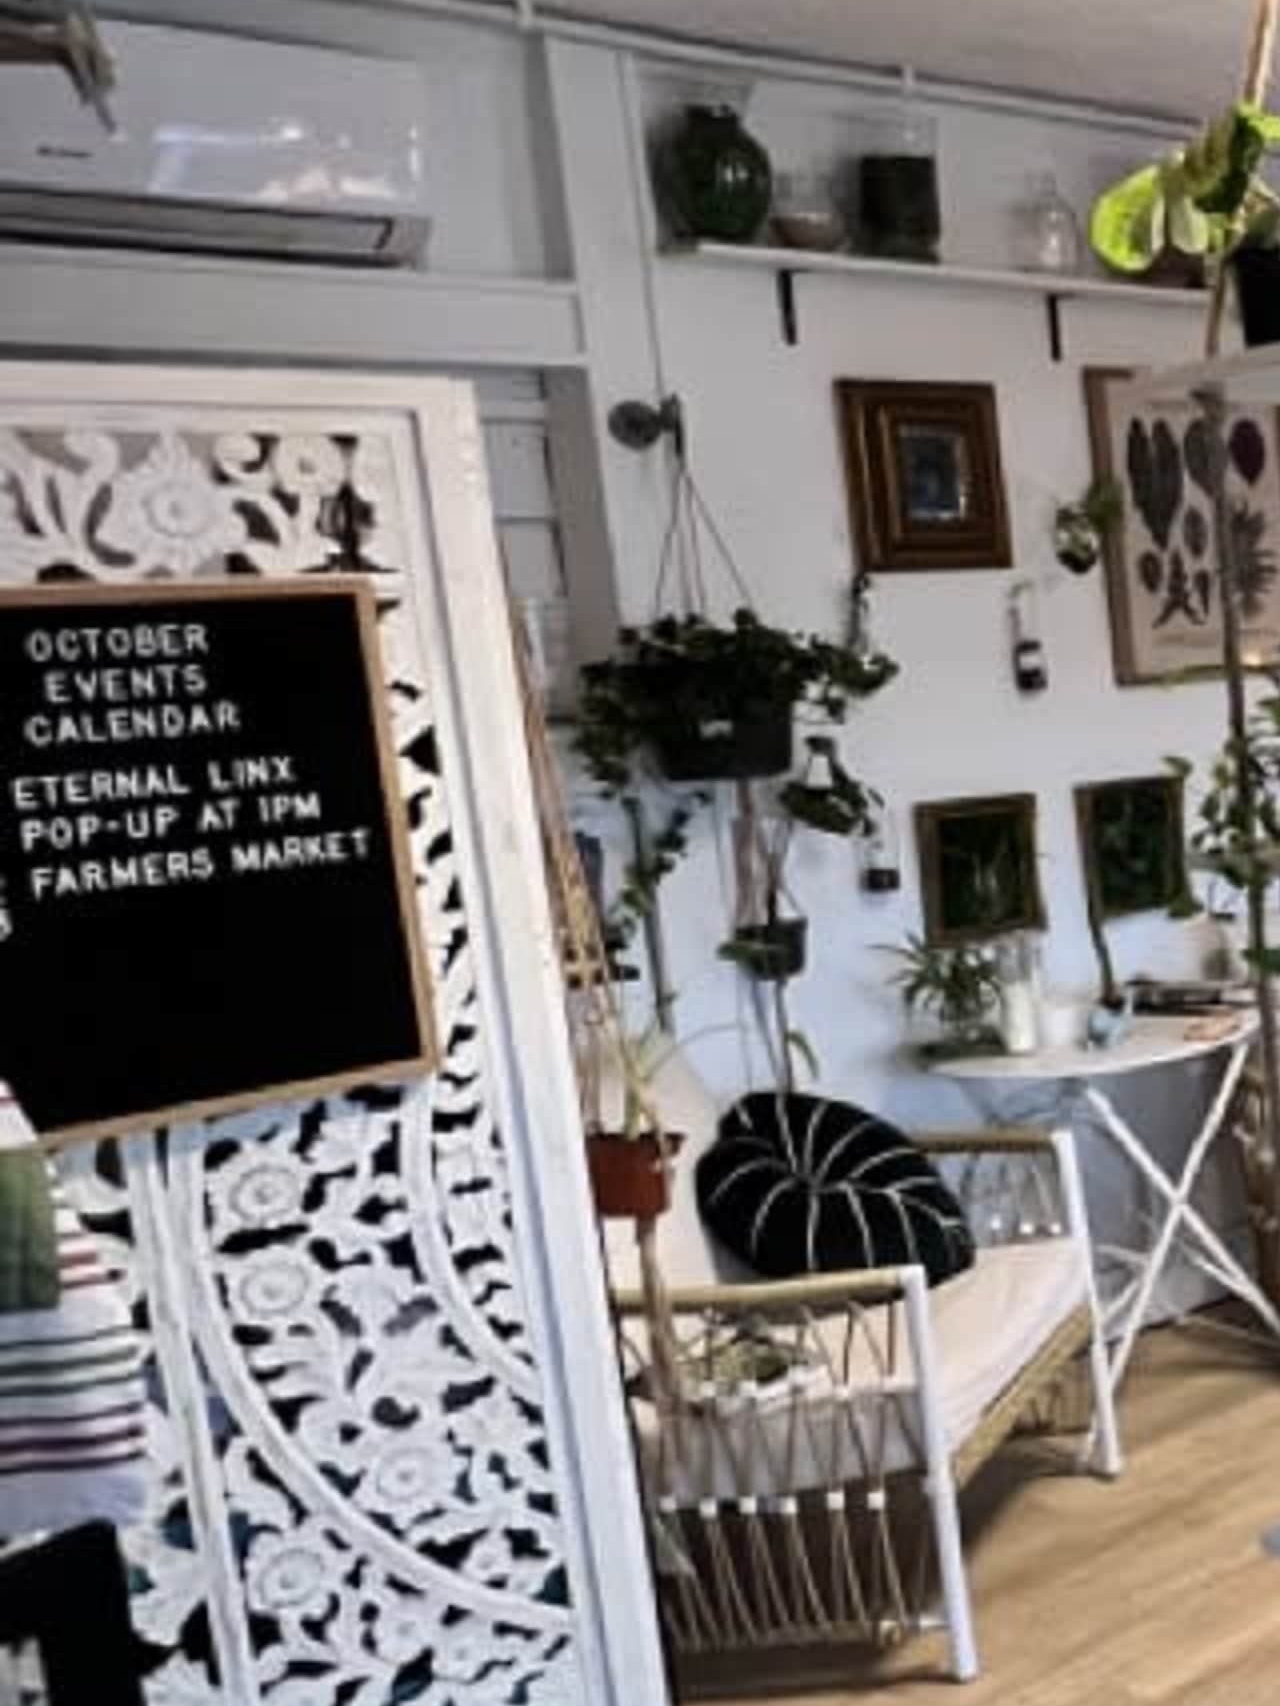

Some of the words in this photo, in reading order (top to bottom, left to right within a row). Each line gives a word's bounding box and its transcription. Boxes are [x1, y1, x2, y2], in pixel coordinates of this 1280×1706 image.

[26, 624, 208, 662] OCTOBER
[44, 663, 207, 703] EVENTS
[24, 700, 241, 746] CALENDAR
[12, 765, 190, 810] ETERNAL
[207, 756, 295, 792] LINX
[20, 805, 179, 851] POP-UP
[199, 797, 239, 831] AT
[258, 792, 321, 823] 1PM
[31, 848, 215, 899] FARMERS
[231, 828, 373, 871] MARKET
